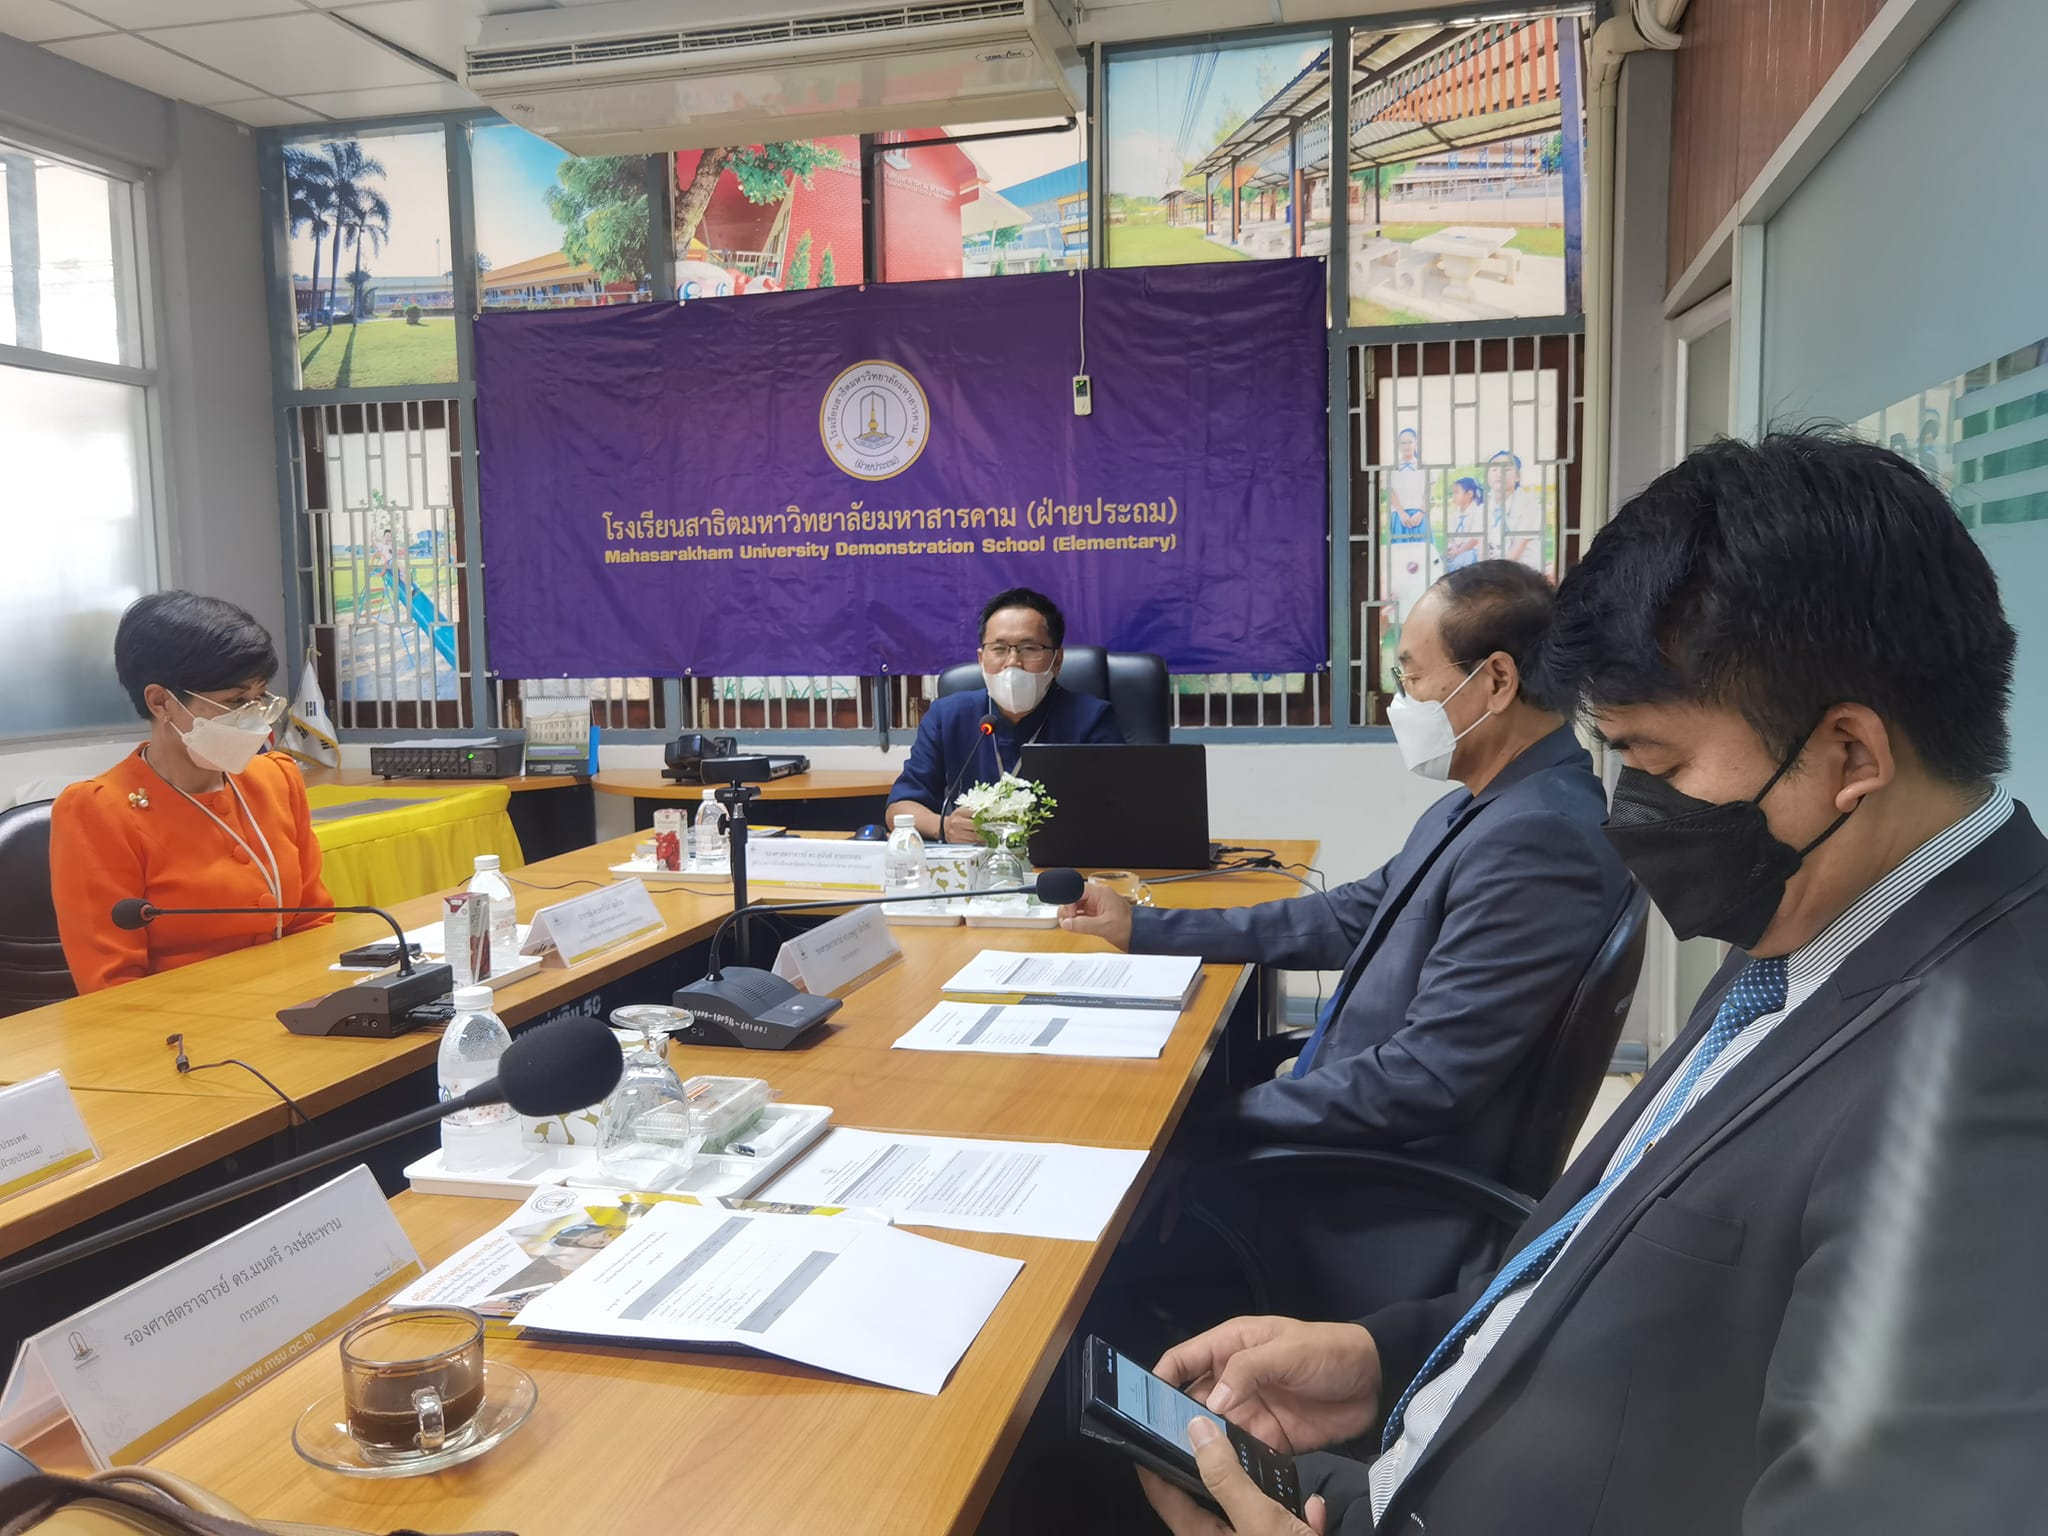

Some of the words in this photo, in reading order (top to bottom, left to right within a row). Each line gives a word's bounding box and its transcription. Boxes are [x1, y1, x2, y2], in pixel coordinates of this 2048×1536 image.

[602, 500, 1017, 540] โรงเรียนสาธิตมหาวิทยาลัยมหาสารคาม
[1026, 496, 1178, 528] (ฝ่ายประถม)
[604, 545, 734, 563] Mahasarakham
[739, 541, 829, 560] University
[835, 538, 975, 557] Demonstration
[982, 536, 1046, 554] School
[1053, 533, 1177, 553] (Elementary)
[0, 1132, 28, 1152] ประเทศ
[123, 1273, 231, 1348] รองศาสตราจารย์
[232, 1247, 285, 1288] ดร.มนตรี
[284, 1215, 343, 1258] วงษ์สะพาน
[238, 1293, 280, 1325] กรรมการ
[233, 1331, 317, 1391] www.msu.ac.th
